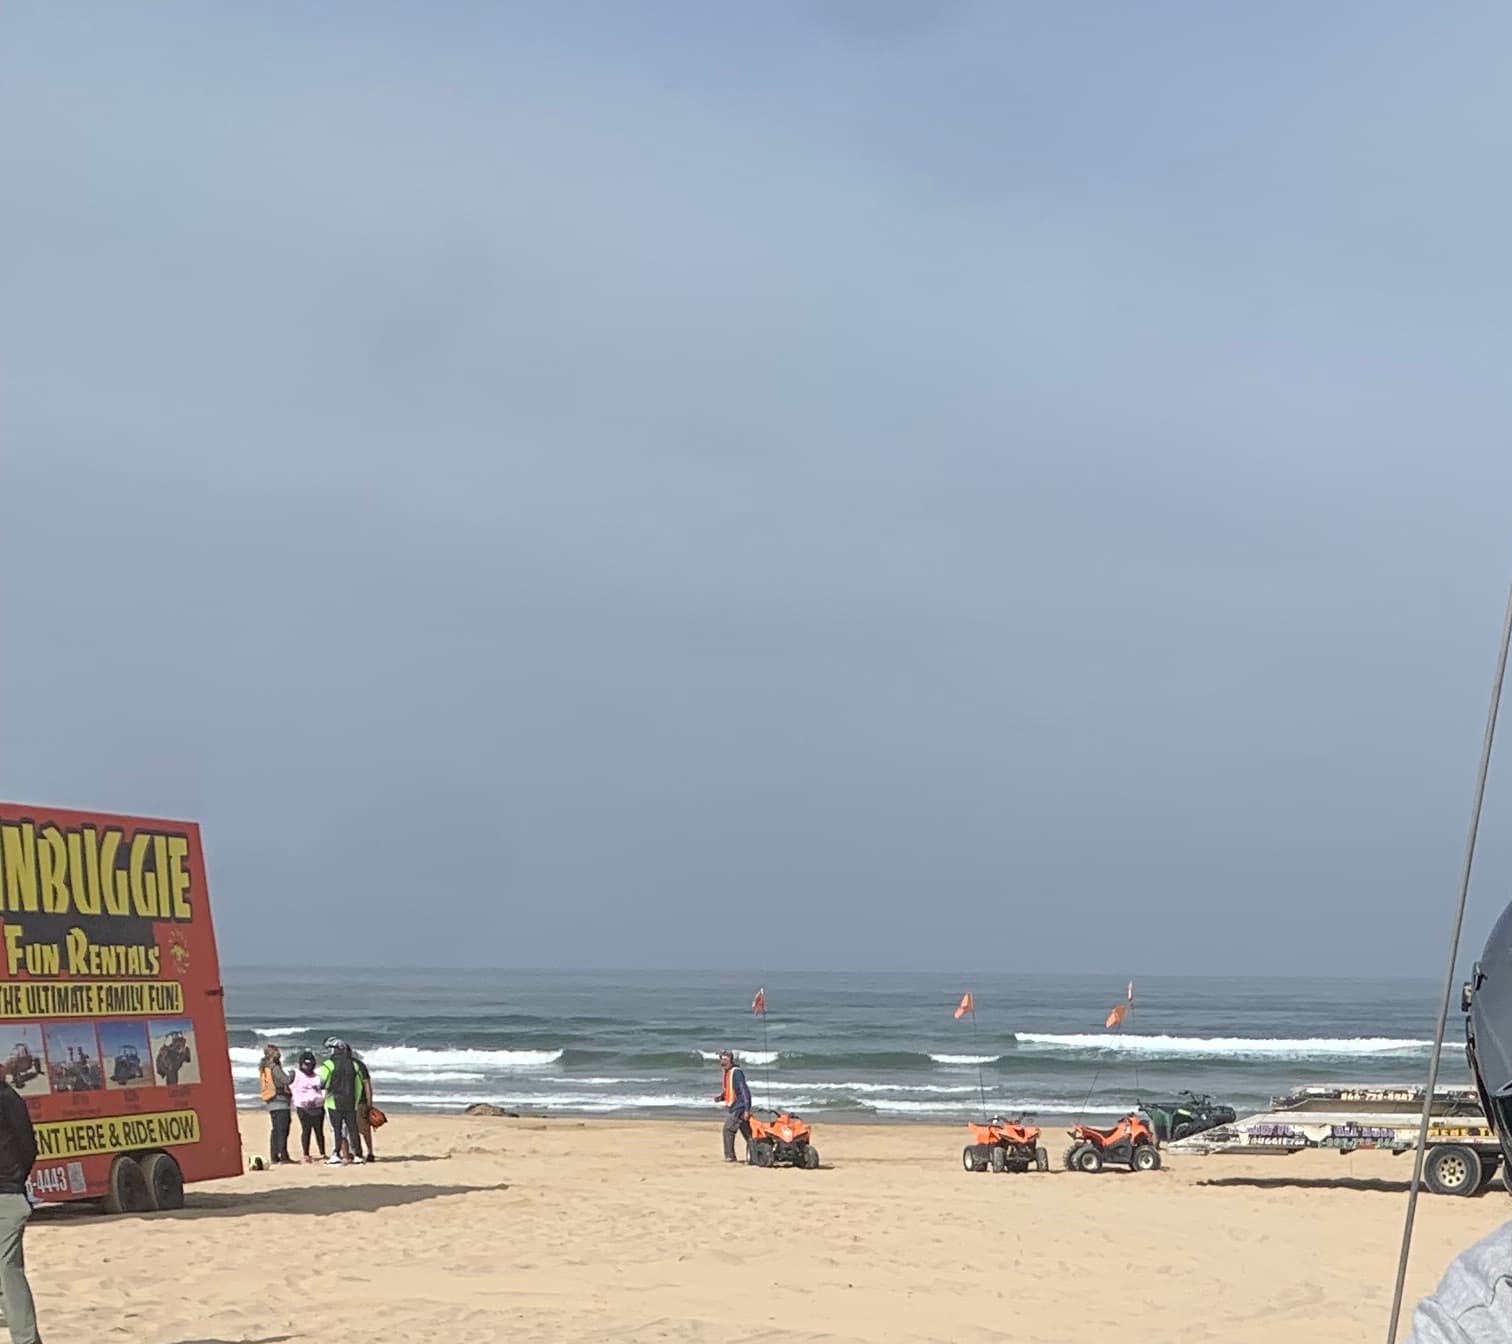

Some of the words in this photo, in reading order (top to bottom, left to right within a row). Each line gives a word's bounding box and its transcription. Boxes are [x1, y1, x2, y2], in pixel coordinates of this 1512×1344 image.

[0, 822, 192, 919] NBUGGIE
[3, 924, 59, 976] FUN
[66, 927, 161, 976] RENTALS
[0, 985, 22, 1015] HE
[25, 985, 93, 1014] ULTIMATE
[97, 984, 144, 1012] FAMILY
[148, 983, 180, 1011] FUN!
[33, 1128, 61, 1155] NT
[64, 1125, 106, 1153] HERE
[109, 1123, 122, 1148] &
[122, 1119, 158, 1146] RIDE
[158, 1115, 195, 1142] NOW
